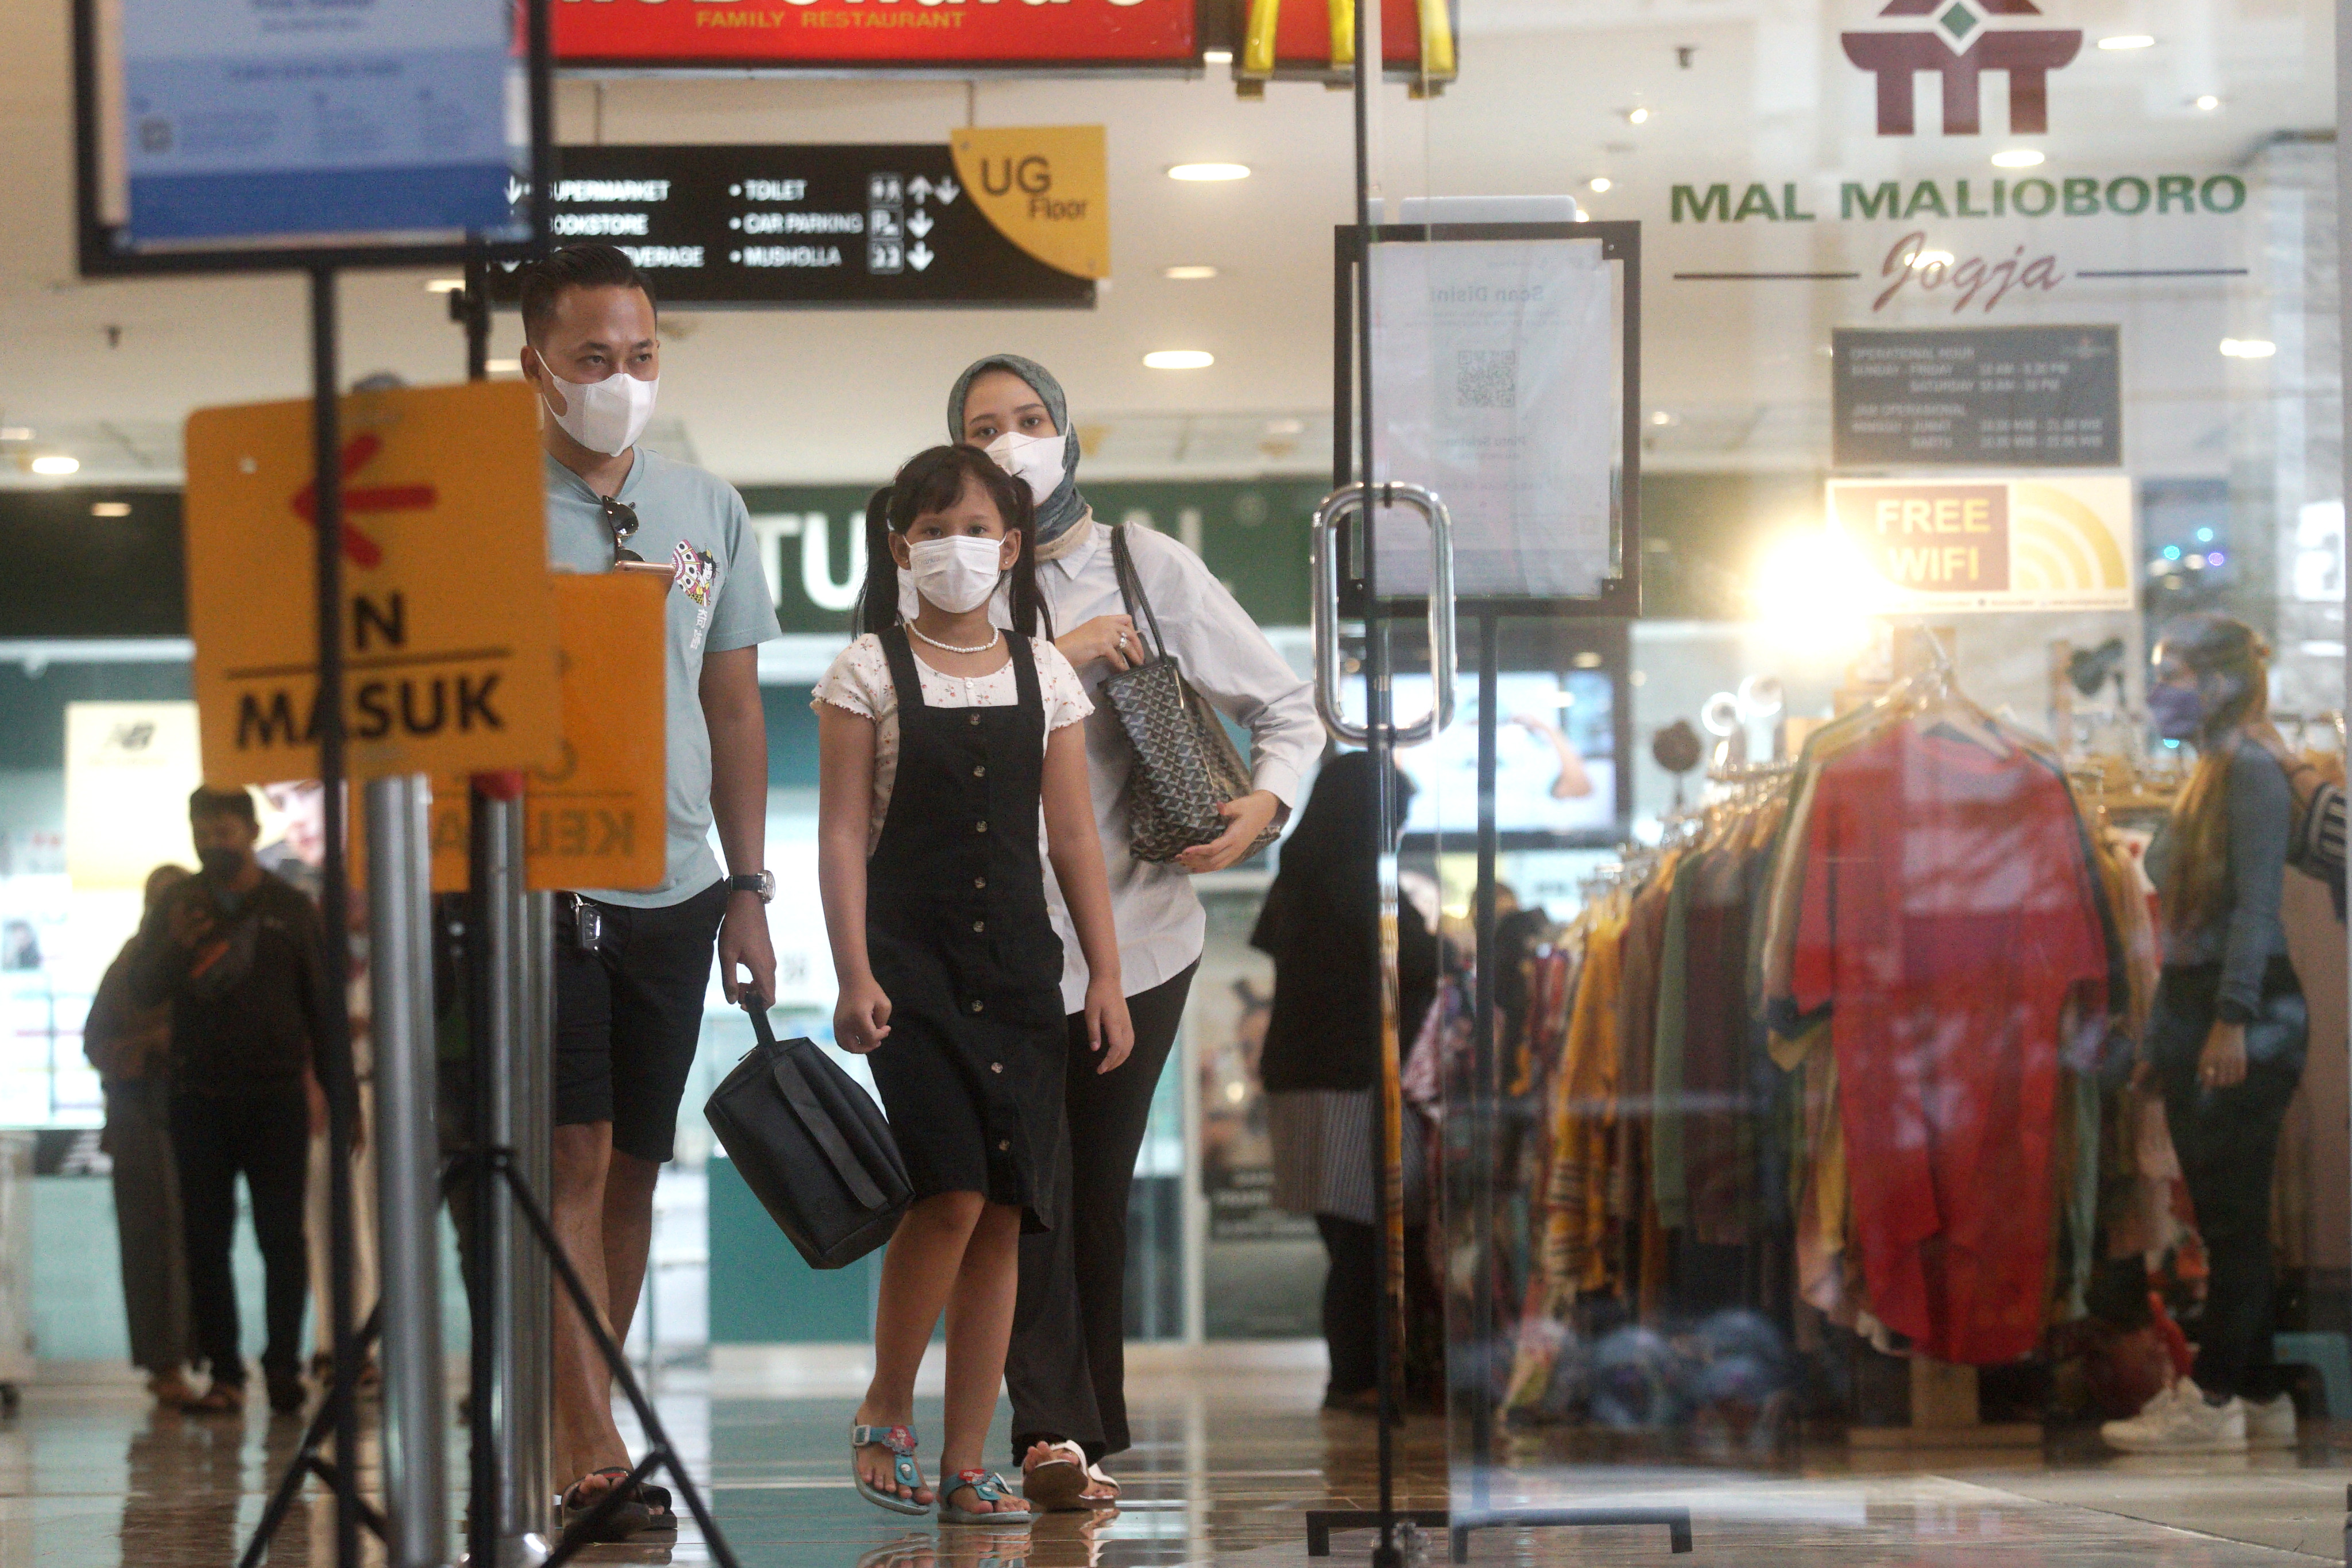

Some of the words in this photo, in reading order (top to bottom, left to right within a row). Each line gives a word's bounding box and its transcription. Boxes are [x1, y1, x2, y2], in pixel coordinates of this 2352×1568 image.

[695, 10, 785, 28] FAMILY
[801, 10, 965, 28] RESTAURANT
[980, 154, 1051, 196] UG
[549, 180, 671, 202] UPERMARKET
[743, 179, 807, 200] TOILET
[1670, 183, 1815, 223] MAL
[1840, 174, 2247, 221] MALIOBORO
[1027, 196, 1086, 221] Floor
[549, 213, 649, 236] OOKSTORE
[743, 212, 783, 234] CAR
[784, 212, 864, 234] PARKING
[743, 246, 842, 268] MUSHOLLA
[1873, 230, 2065, 313] Jogja
[1875, 499, 1991, 535] FREE
[1889, 546, 1980, 582] WIFI
[353, 590, 406, 651] N
